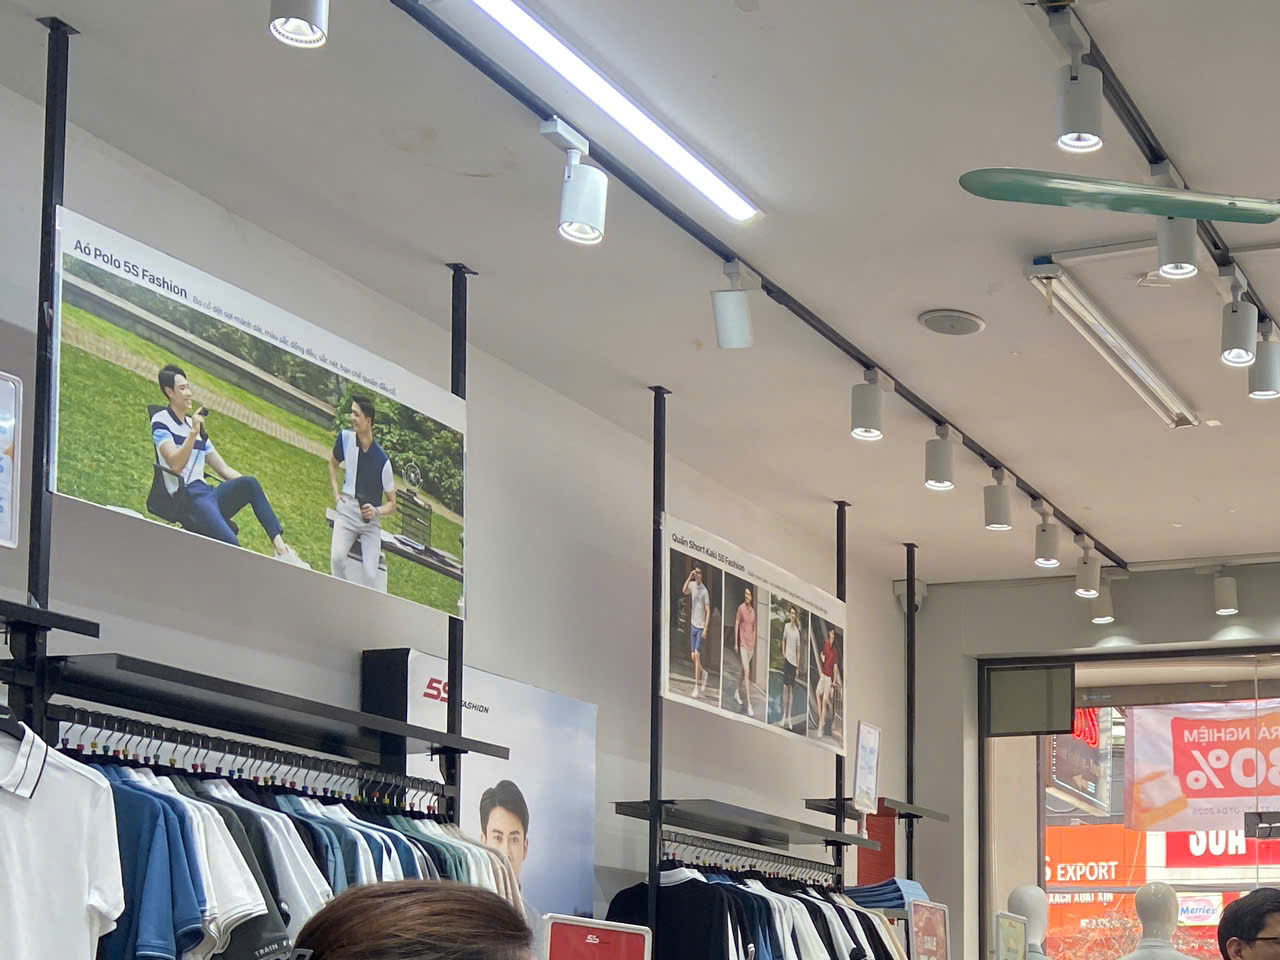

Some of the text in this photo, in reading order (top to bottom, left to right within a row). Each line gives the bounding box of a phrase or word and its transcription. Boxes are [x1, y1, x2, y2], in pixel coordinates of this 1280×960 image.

[94, 247, 121, 269] Polo
[123, 260, 140, 278] 5S
[142, 268, 188, 299] Fashion
[688, 540, 706, 553] Short
[725, 556, 745, 572] Fashion
[1057, 861, 1119, 882] EXPORT
[1180, 906, 1218, 917] Merries
[254, 943, 279, 957] TRAIN
